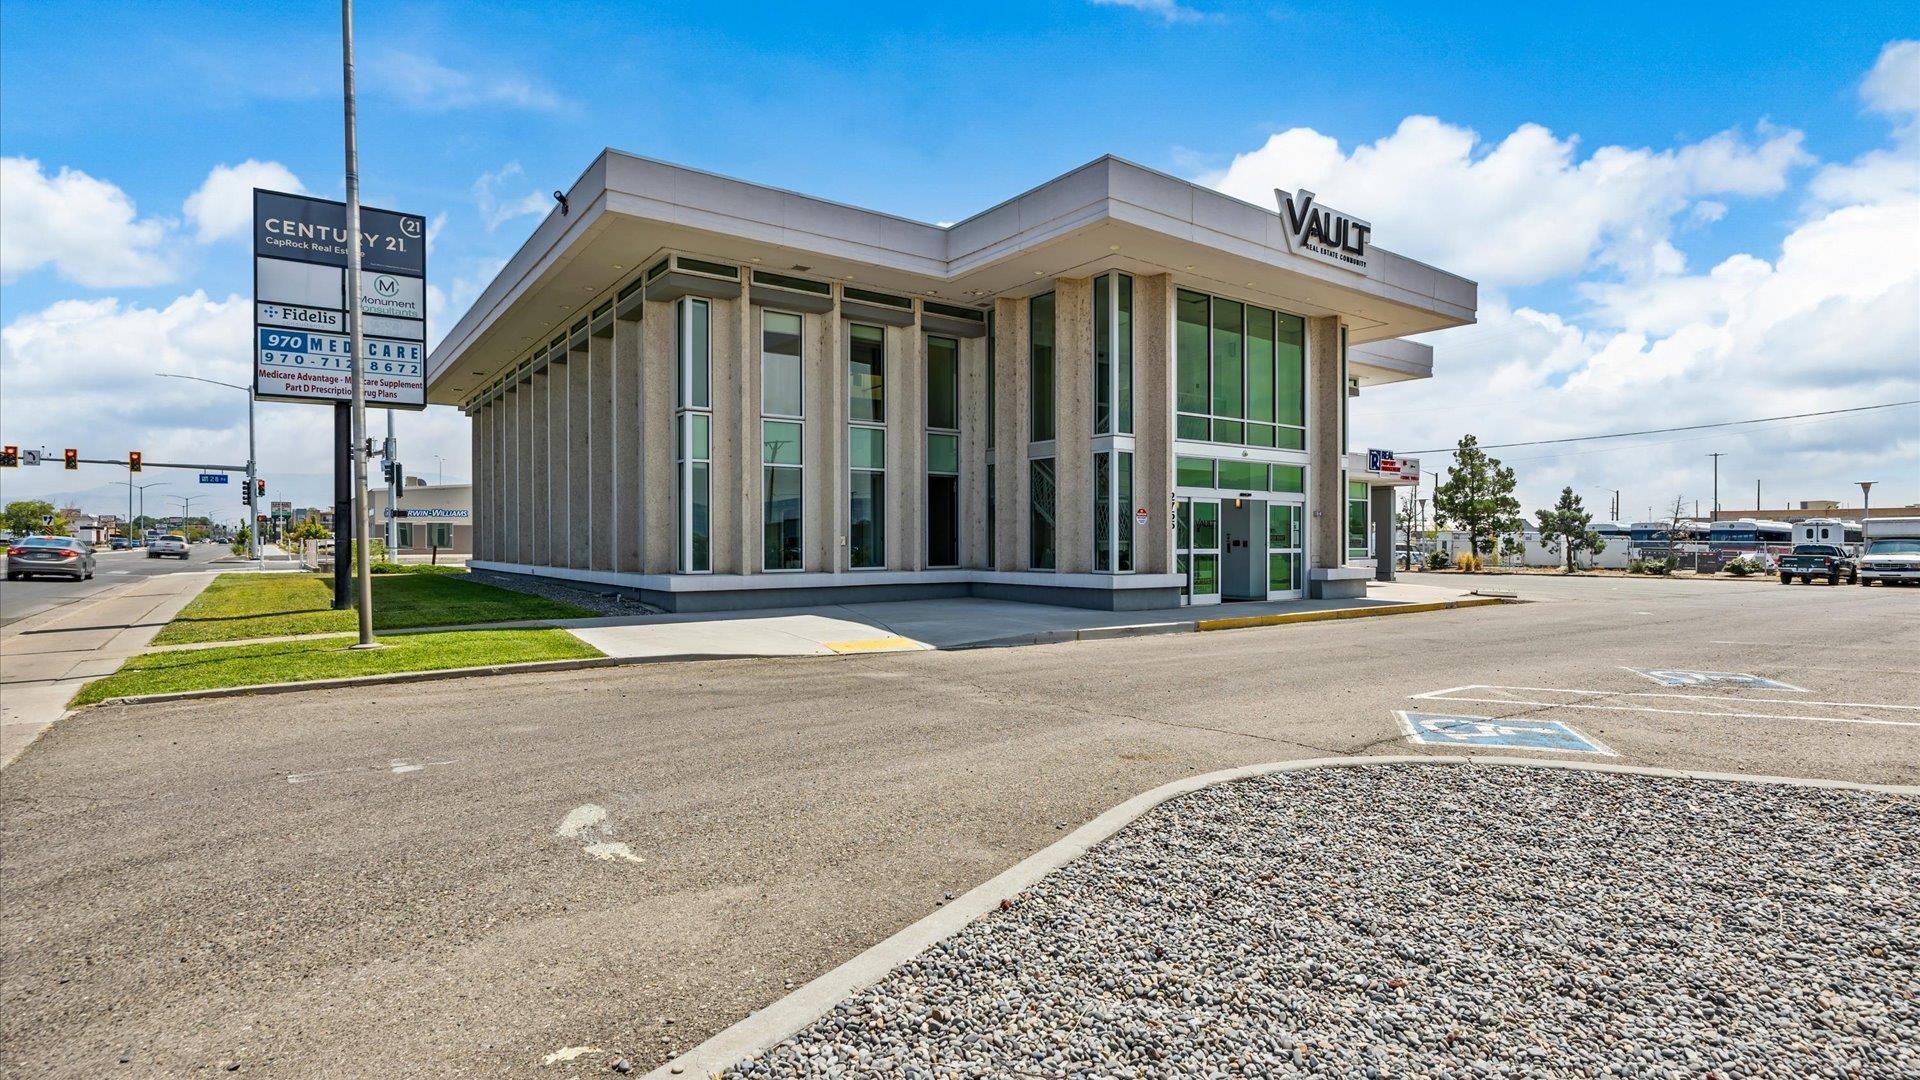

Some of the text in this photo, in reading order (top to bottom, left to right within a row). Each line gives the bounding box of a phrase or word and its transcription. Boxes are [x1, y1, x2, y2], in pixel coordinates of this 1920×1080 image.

[407, 220, 420, 233] 21
[1286, 196, 1371, 256] VAULT
[265, 236, 310, 250] CapRock
[311, 243, 332, 253] Real
[385, 236, 405, 252] 21
[1306, 243, 1319, 254] REAL
[1320, 247, 1339, 260] ESTATE
[282, 308, 336, 324] Fidelis
[361, 304, 418, 318] onsultants
[268, 334, 419, 360] 970 MEDCARE
[265, 352, 418, 374] 970-7128672
[258, 369, 296, 380] Medicare
[297, 372, 339, 385] Advantage
[379, 378, 423, 390] Supplement
[285, 383, 302, 392] Part
[311, 385, 352, 396] Prescriptio
[364, 390, 377, 399] rug
[378, 390, 398, 399] Plans
